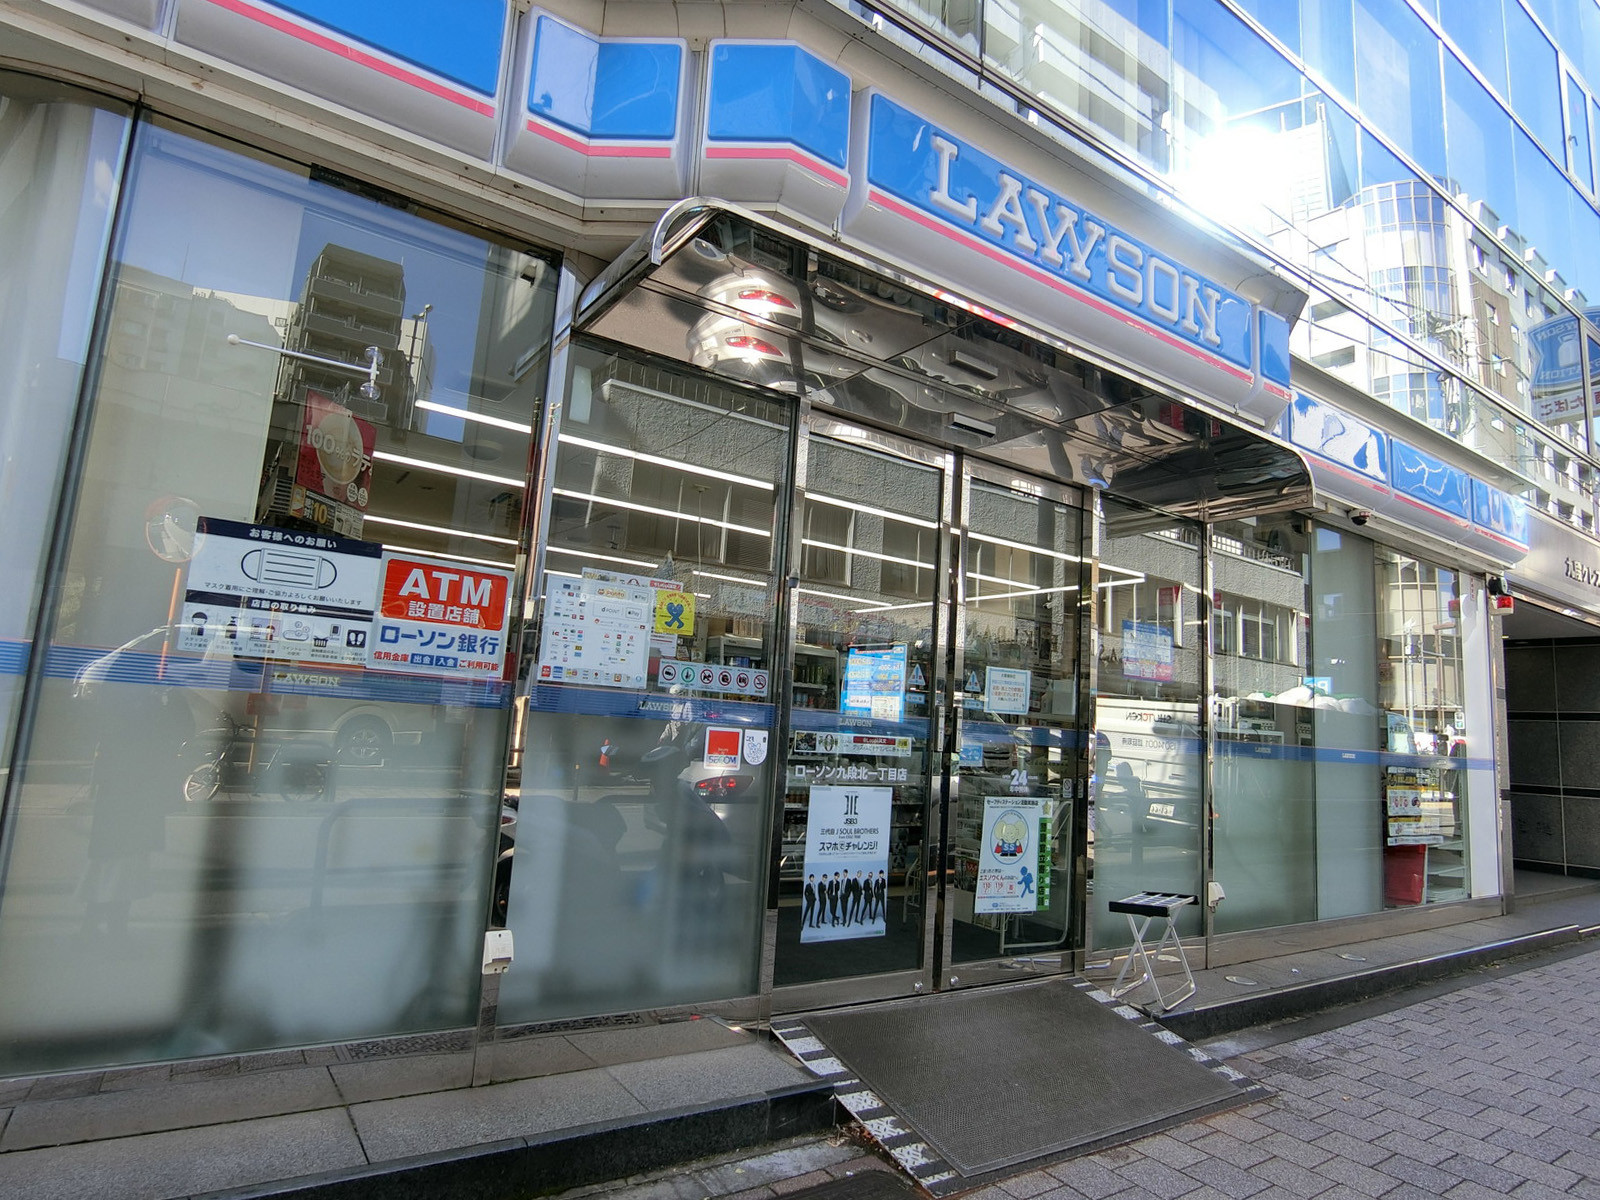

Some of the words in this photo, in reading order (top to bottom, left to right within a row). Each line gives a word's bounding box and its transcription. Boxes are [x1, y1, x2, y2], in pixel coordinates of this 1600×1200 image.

[930, 133, 1221, 347] LAWSON
[249, 528, 338, 548] お客様へのお願い
[398, 567, 492, 607] ATM
[407, 600, 481, 625] 設置店舗
[380, 625, 500, 655] ローソン銀行
[373, 651, 410, 662] 信用金庫
[412, 654, 431, 666] 出金
[437, 657, 455, 668] 入金
[458, 660, 499, 671] ご利用可能
[272, 672, 341, 686] LAWSON
[638, 700, 684, 713] LAWS
[708, 756, 737, 765] SECOM
[795, 765, 908, 782] ローソン九段北一丁目店
[1010, 768, 1028, 786] 24
